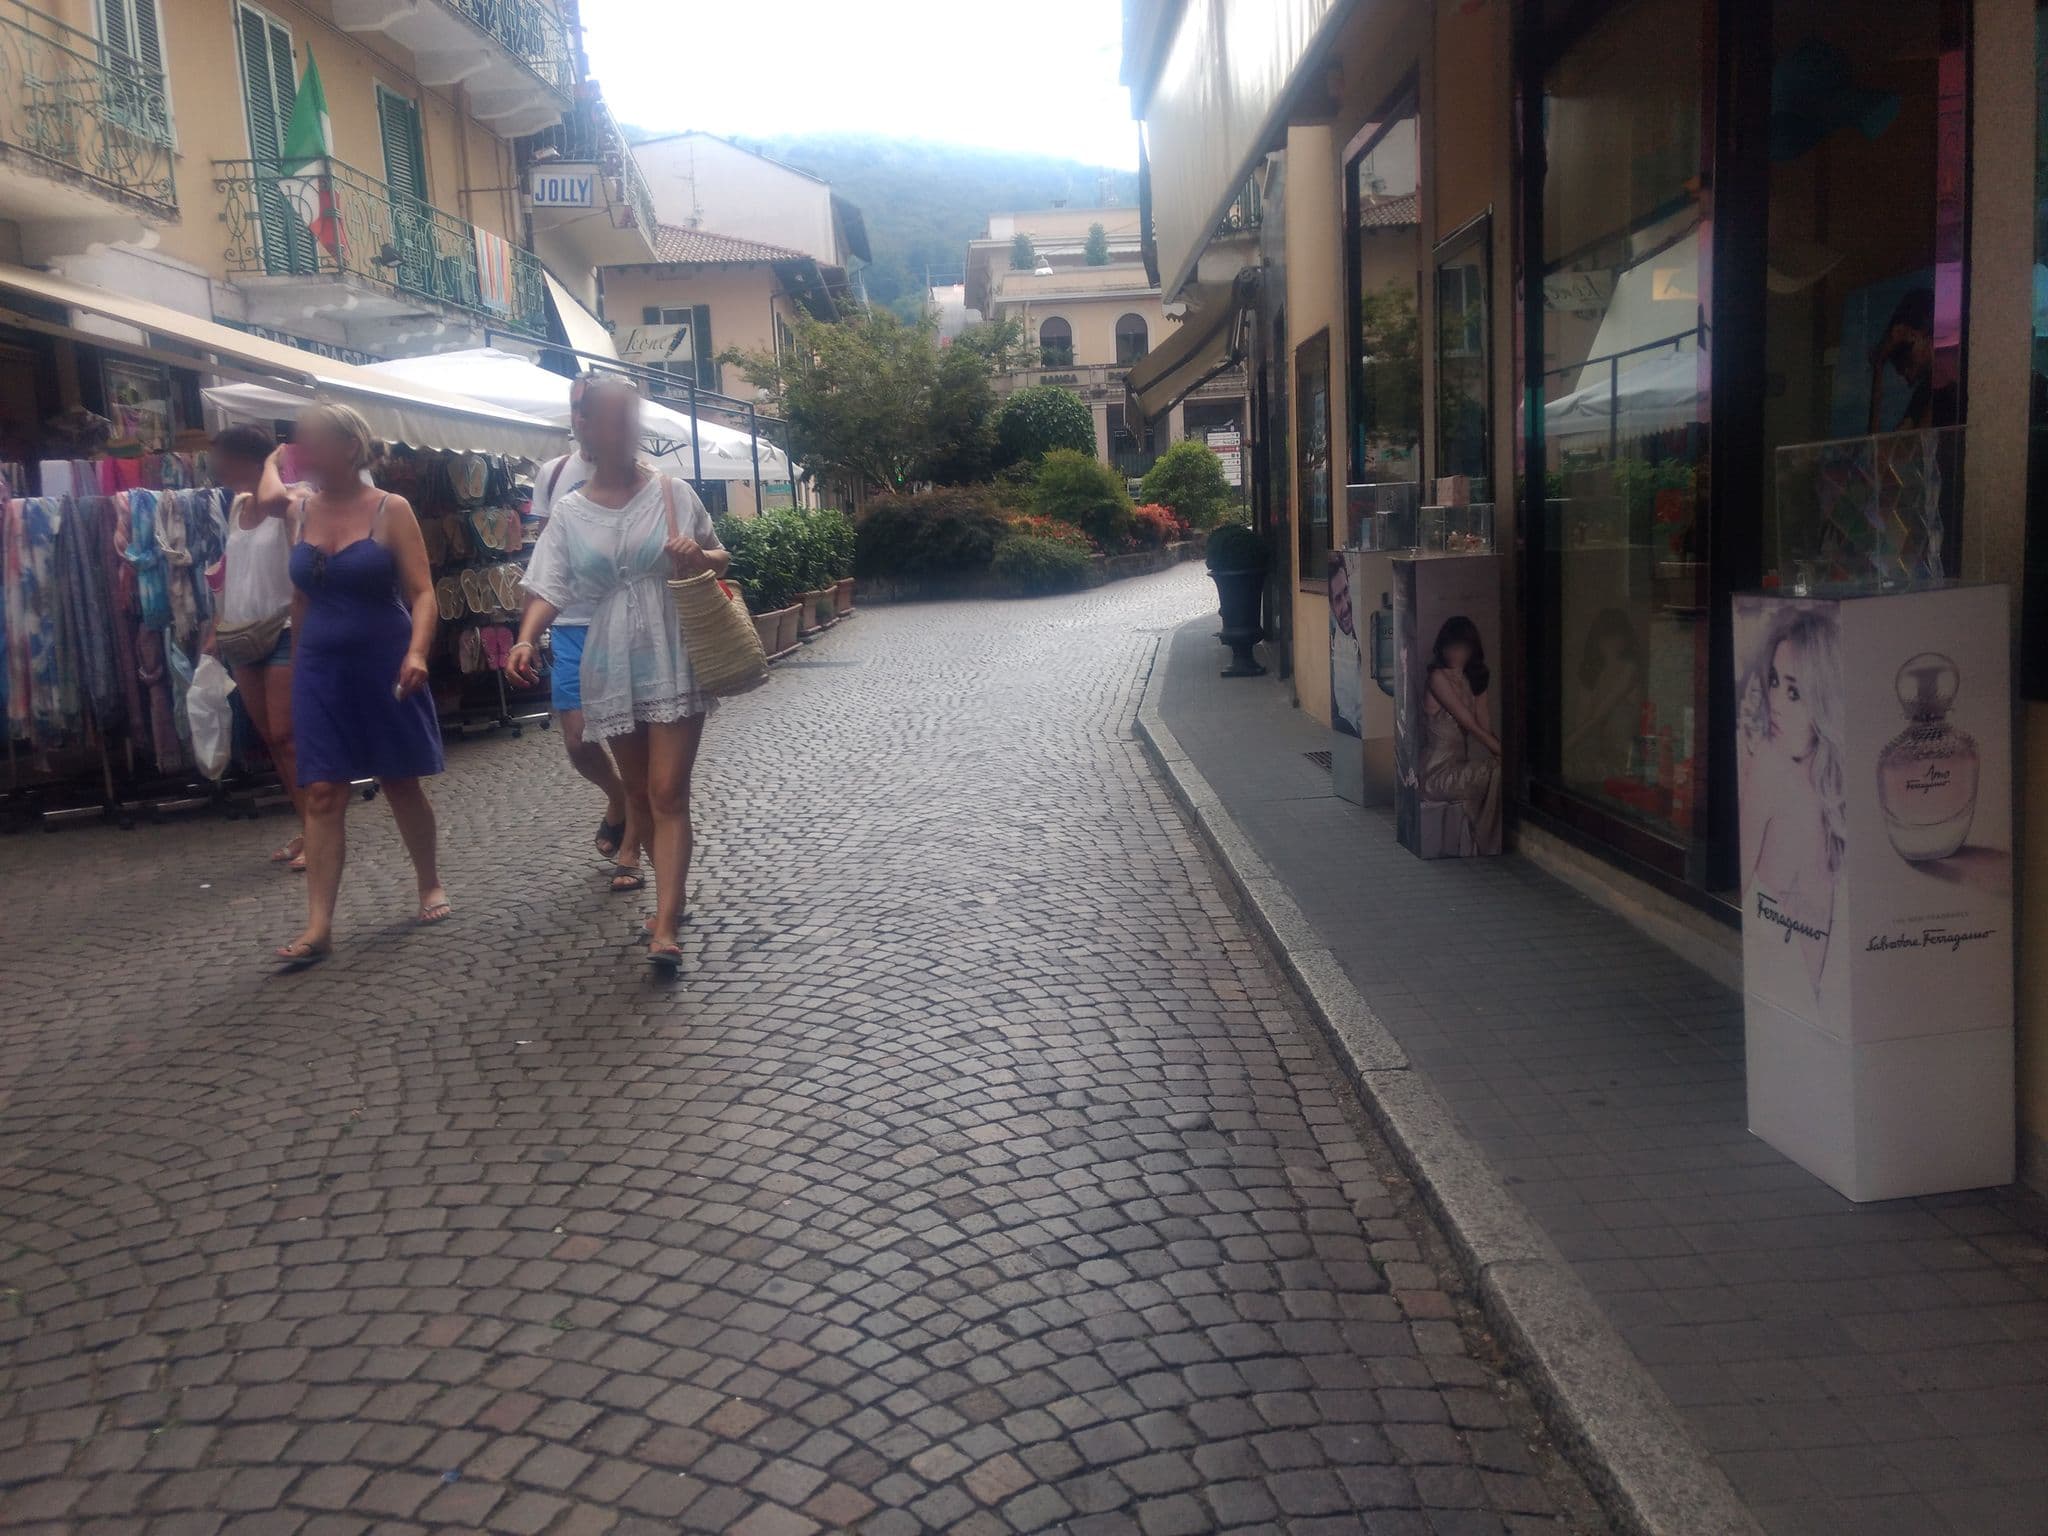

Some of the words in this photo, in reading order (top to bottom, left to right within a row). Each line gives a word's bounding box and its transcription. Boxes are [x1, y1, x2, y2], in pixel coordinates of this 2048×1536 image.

[534, 178, 589, 202] JOLLY
[1756, 892, 1830, 943] Ferragamo
[1865, 932, 1921, 951] Salvatore
[1921, 928, 1996, 952] Ferragamo
